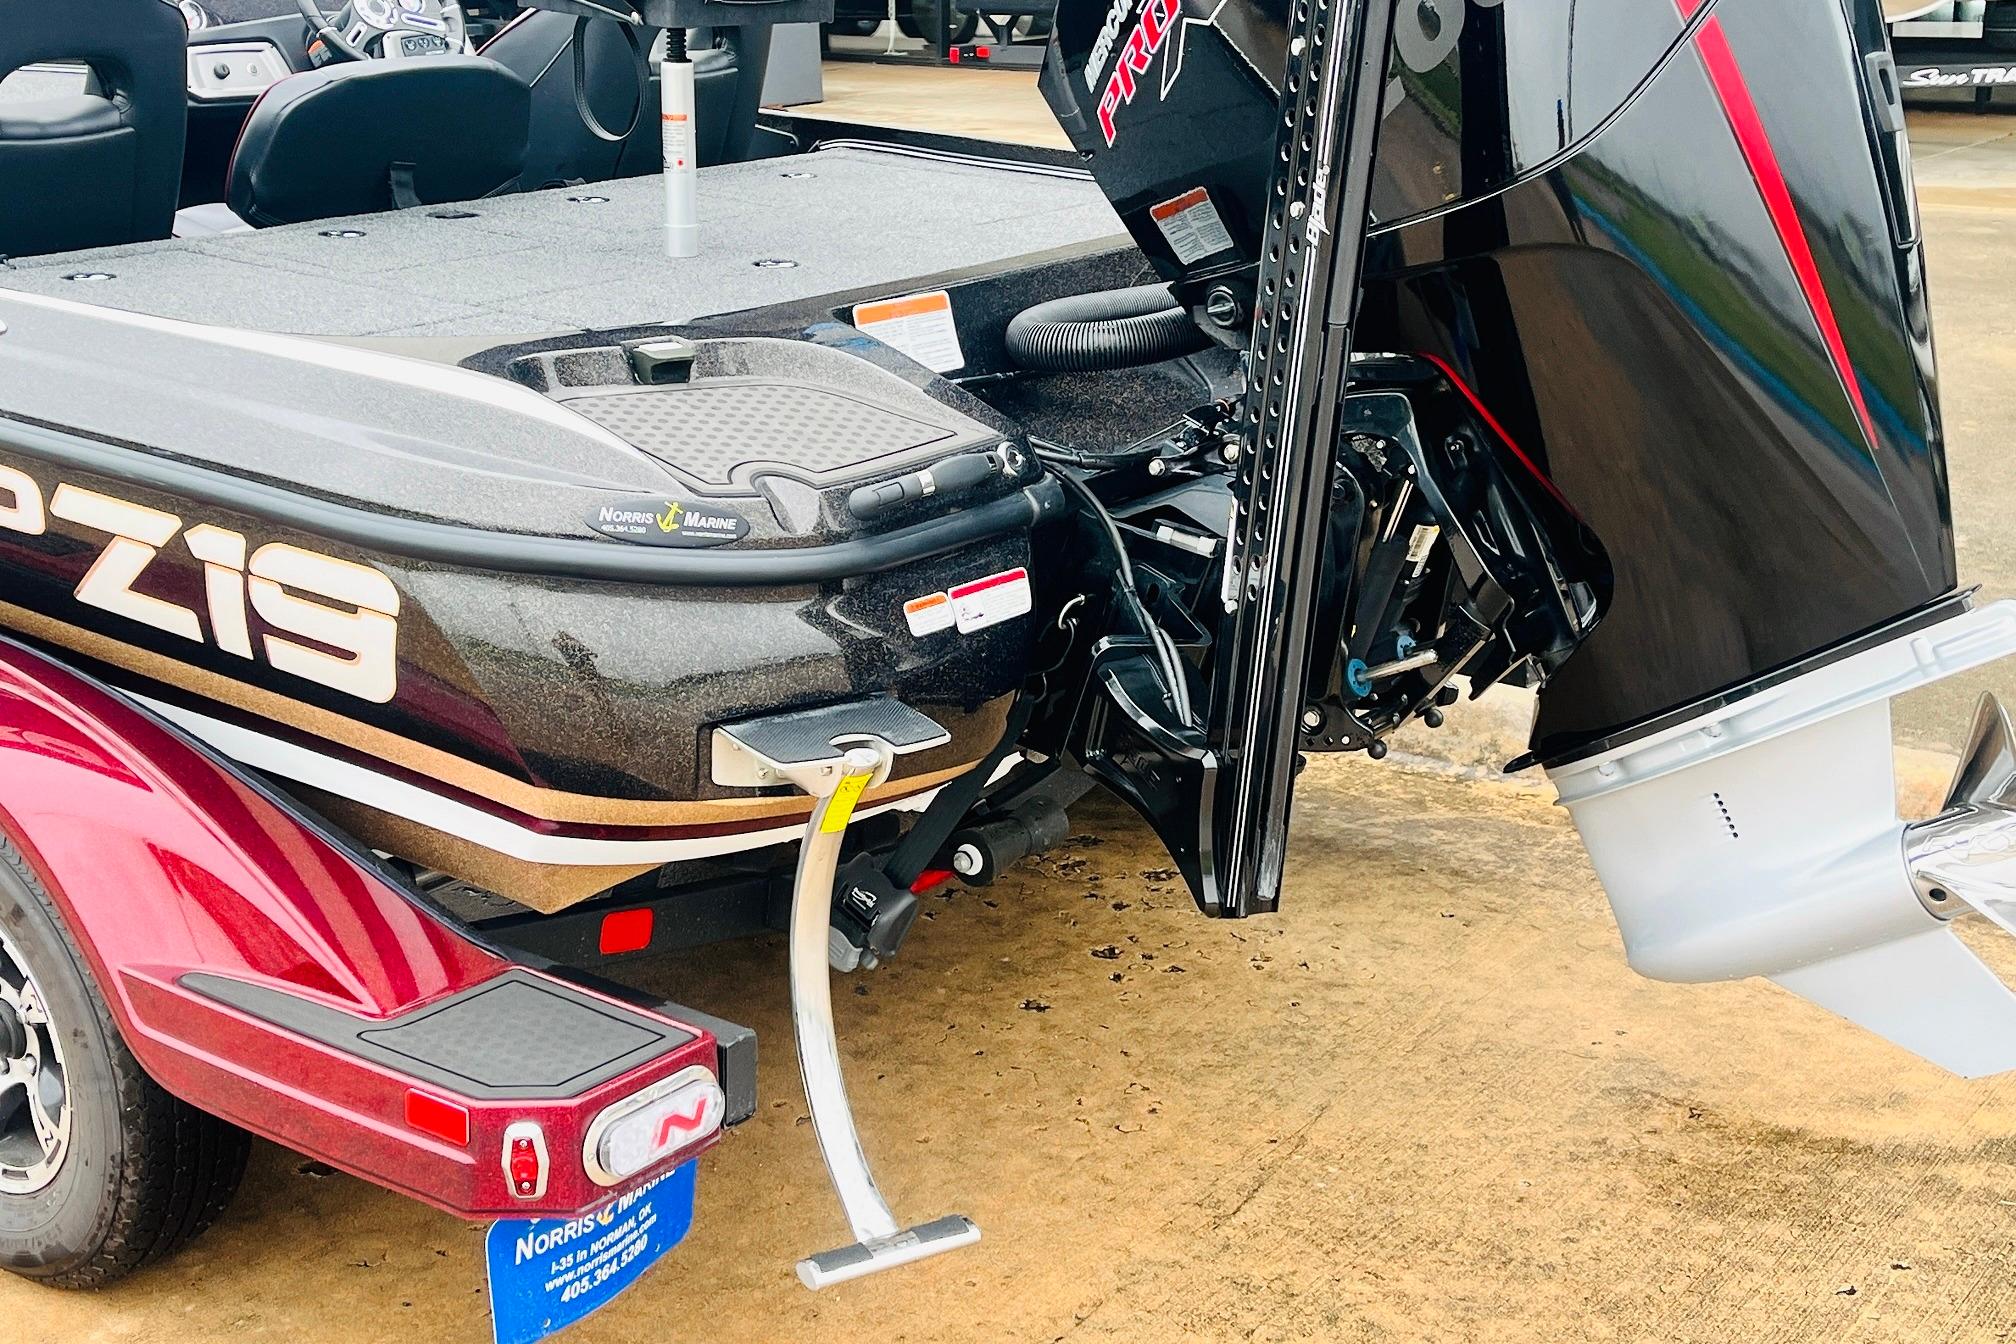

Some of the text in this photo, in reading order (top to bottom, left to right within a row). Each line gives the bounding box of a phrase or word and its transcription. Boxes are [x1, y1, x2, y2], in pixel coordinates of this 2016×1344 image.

[1084, 0, 1133, 94] MERCU
[1902, 67, 1970, 87] Sun
[599, 506, 738, 531] NORRIS MARINE
[50, 482, 401, 704] Z19
[514, 1213, 596, 1266] NORRIS
[576, 1248, 588, 1264] in
[638, 1202, 653, 1222] OK
[560, 1234, 649, 1304] 405.364.5280
